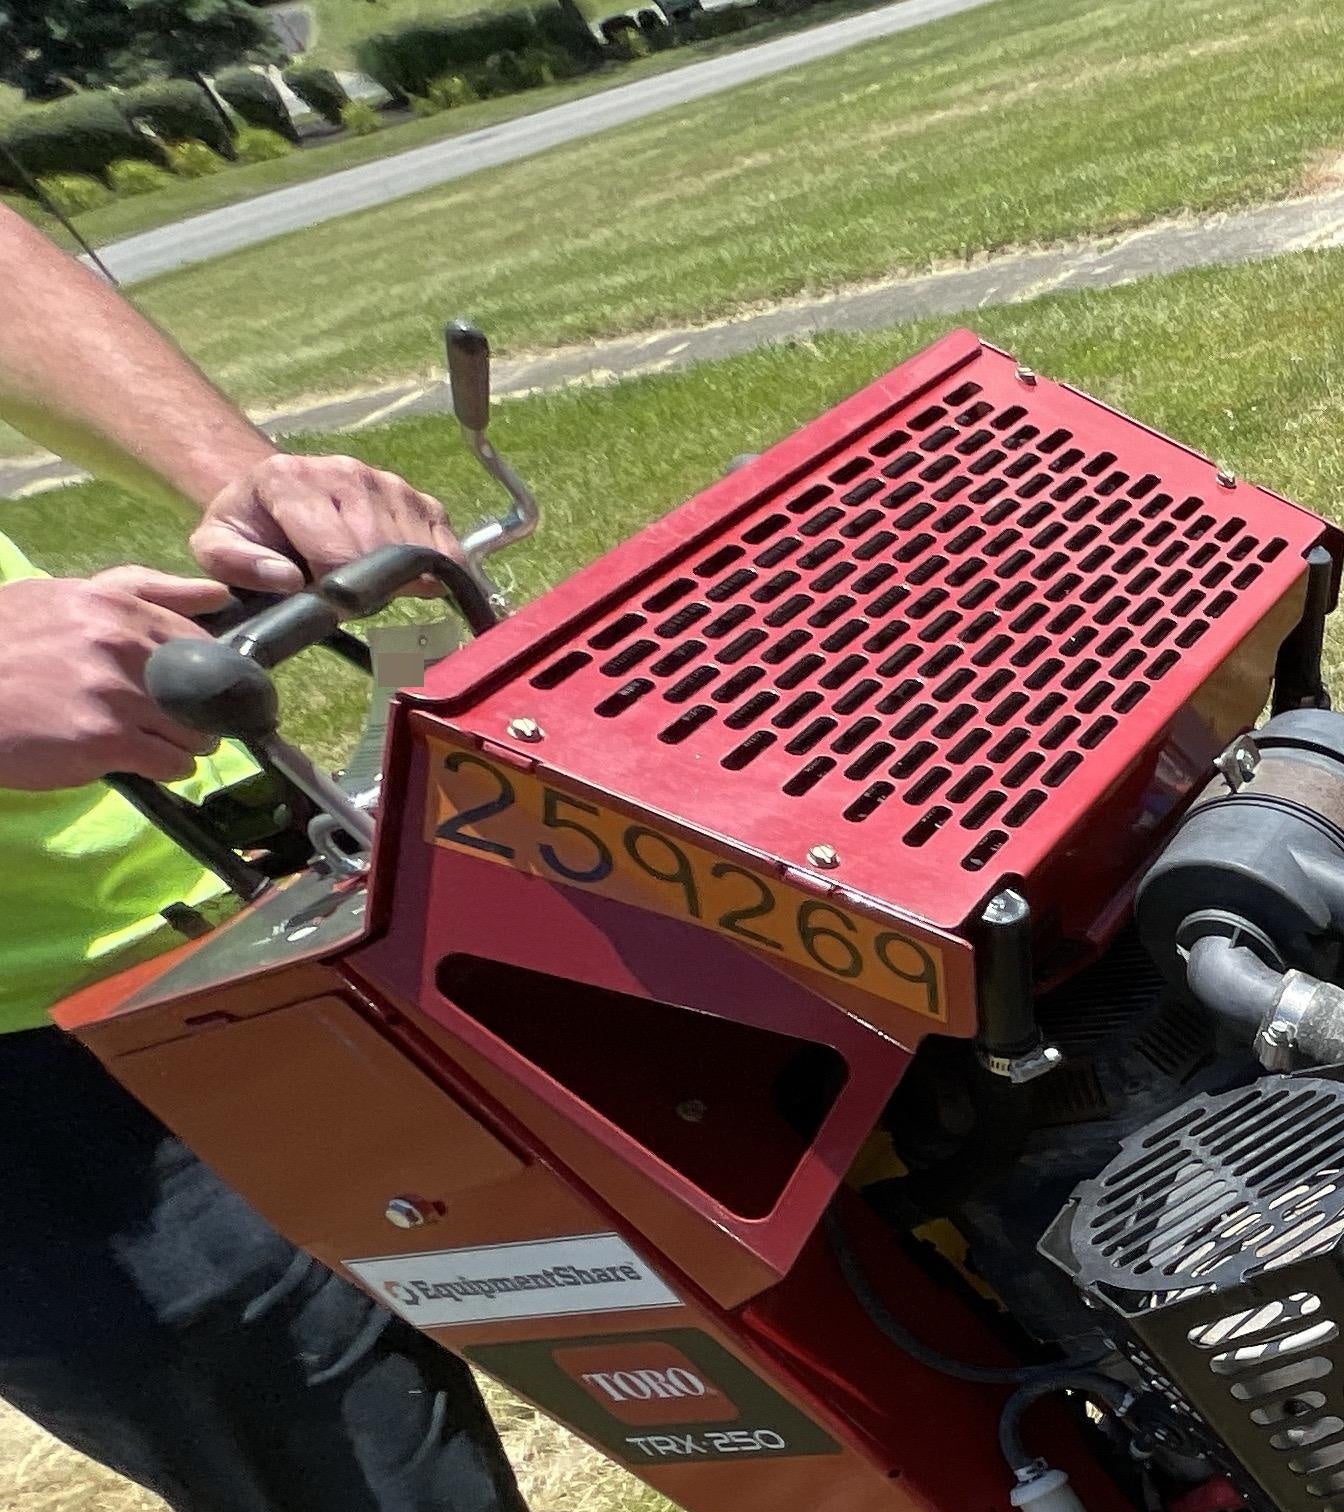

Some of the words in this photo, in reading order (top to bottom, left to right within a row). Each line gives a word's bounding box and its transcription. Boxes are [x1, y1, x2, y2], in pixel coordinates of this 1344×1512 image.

[433, 751, 940, 1015] 259269
[409, 1264, 643, 1302] EquipmentShare
[581, 1367, 706, 1402] TORO
[625, 1428, 786, 1457] TRX-250
